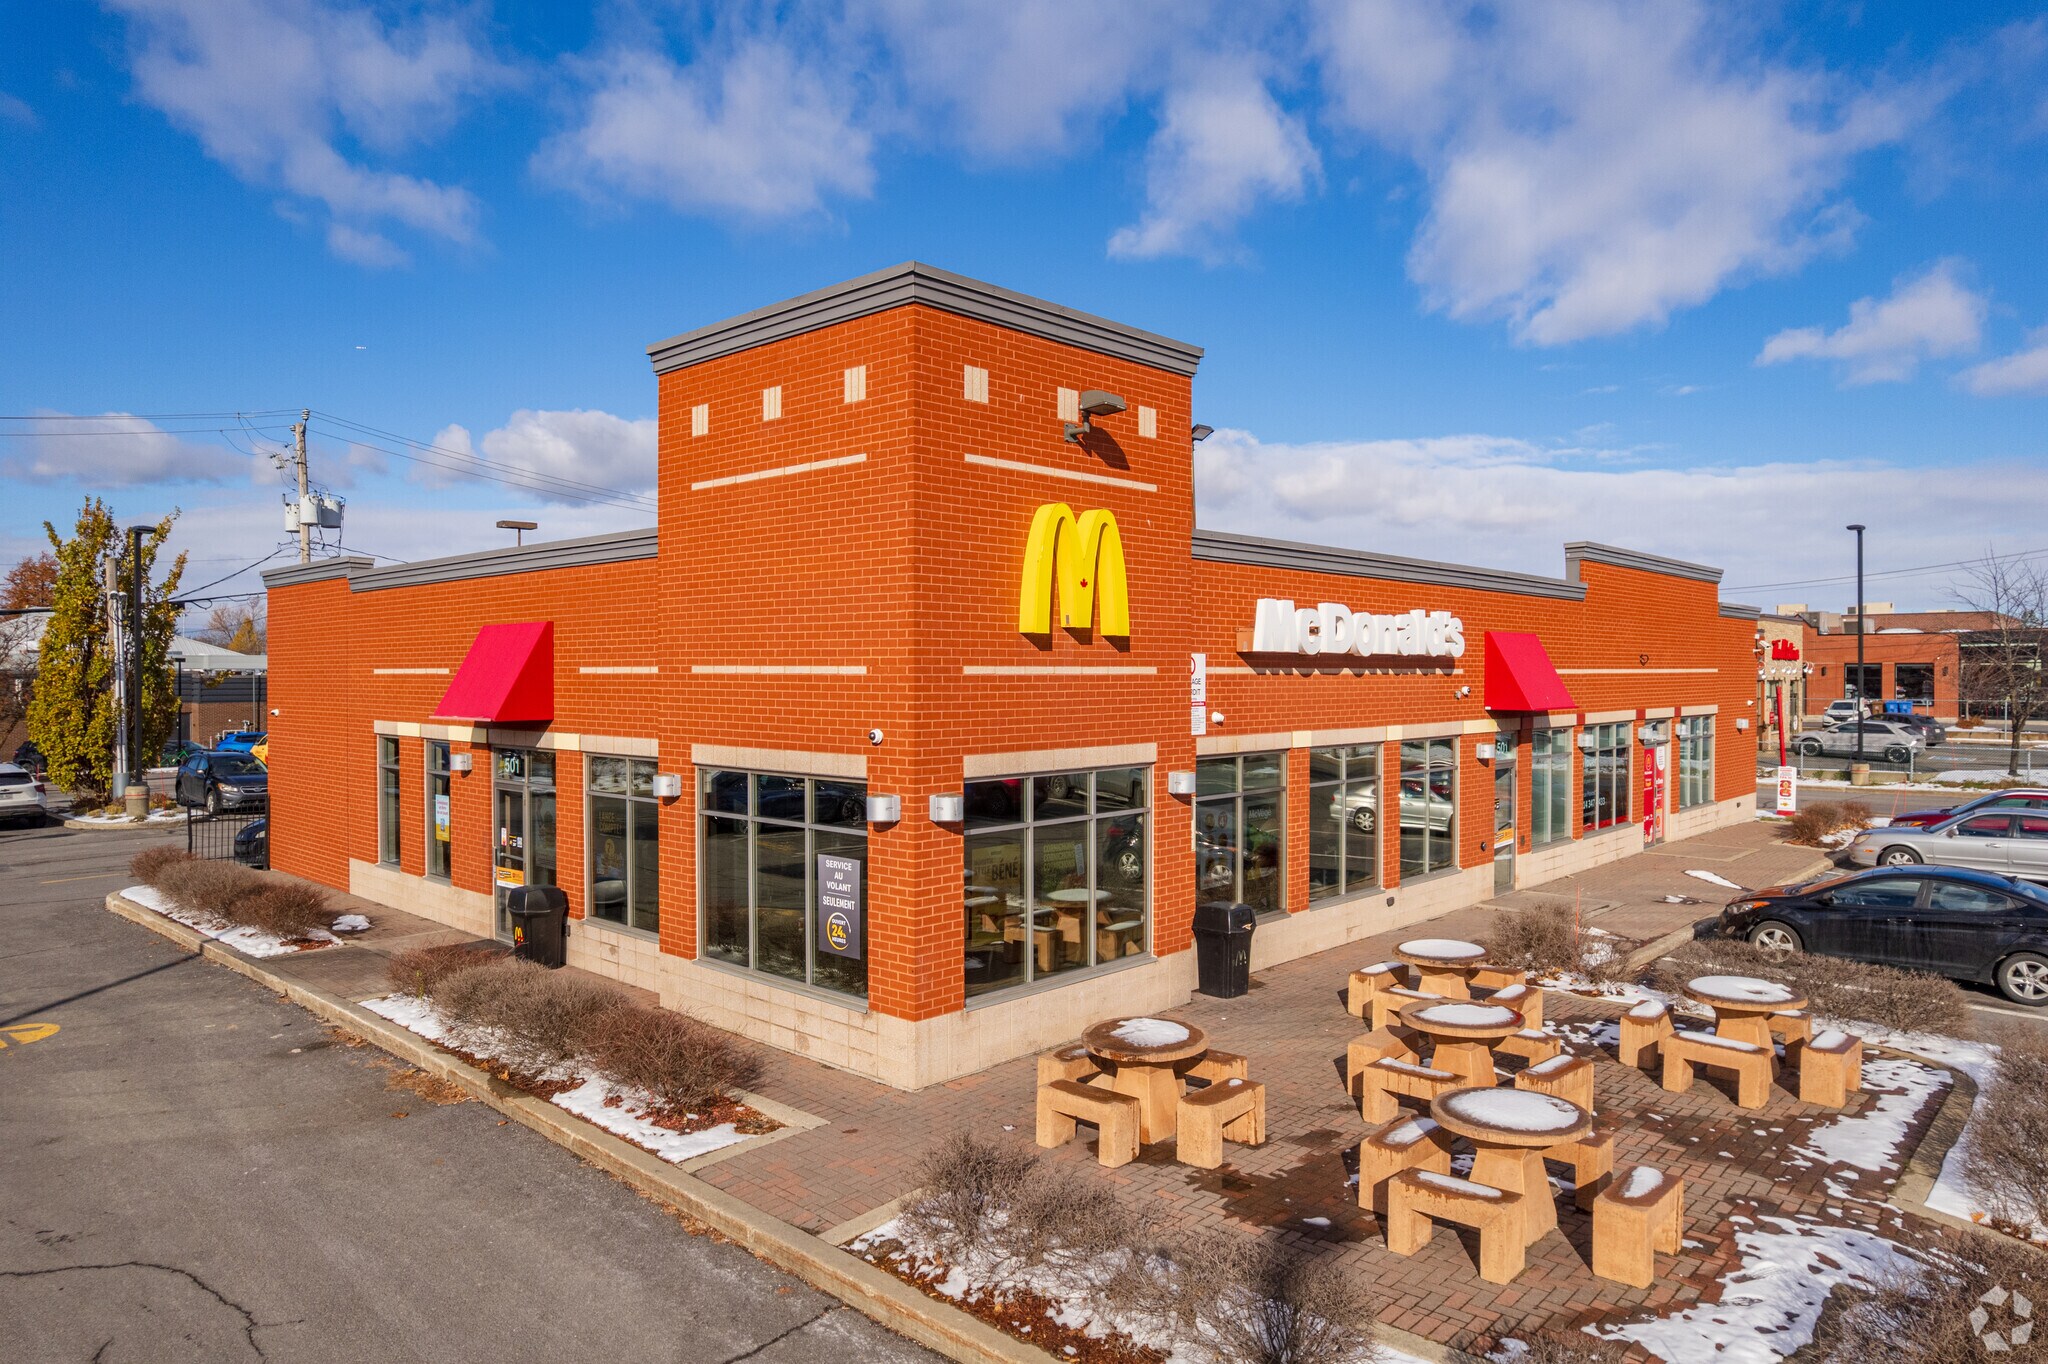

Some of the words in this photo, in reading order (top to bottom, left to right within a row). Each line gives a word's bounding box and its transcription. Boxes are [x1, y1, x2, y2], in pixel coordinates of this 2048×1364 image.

[1253, 598, 1466, 657] McDonald's
[1496, 742, 1508, 752] 501
[504, 757, 519, 774] 501
[825, 859, 852, 871] SERVICE
[991, 856, 1019, 881] BÉNÉ
[834, 871, 843, 880] AU
[826, 880, 852, 893] VOLANT
[822, 895, 855, 911] SEULEMENT
